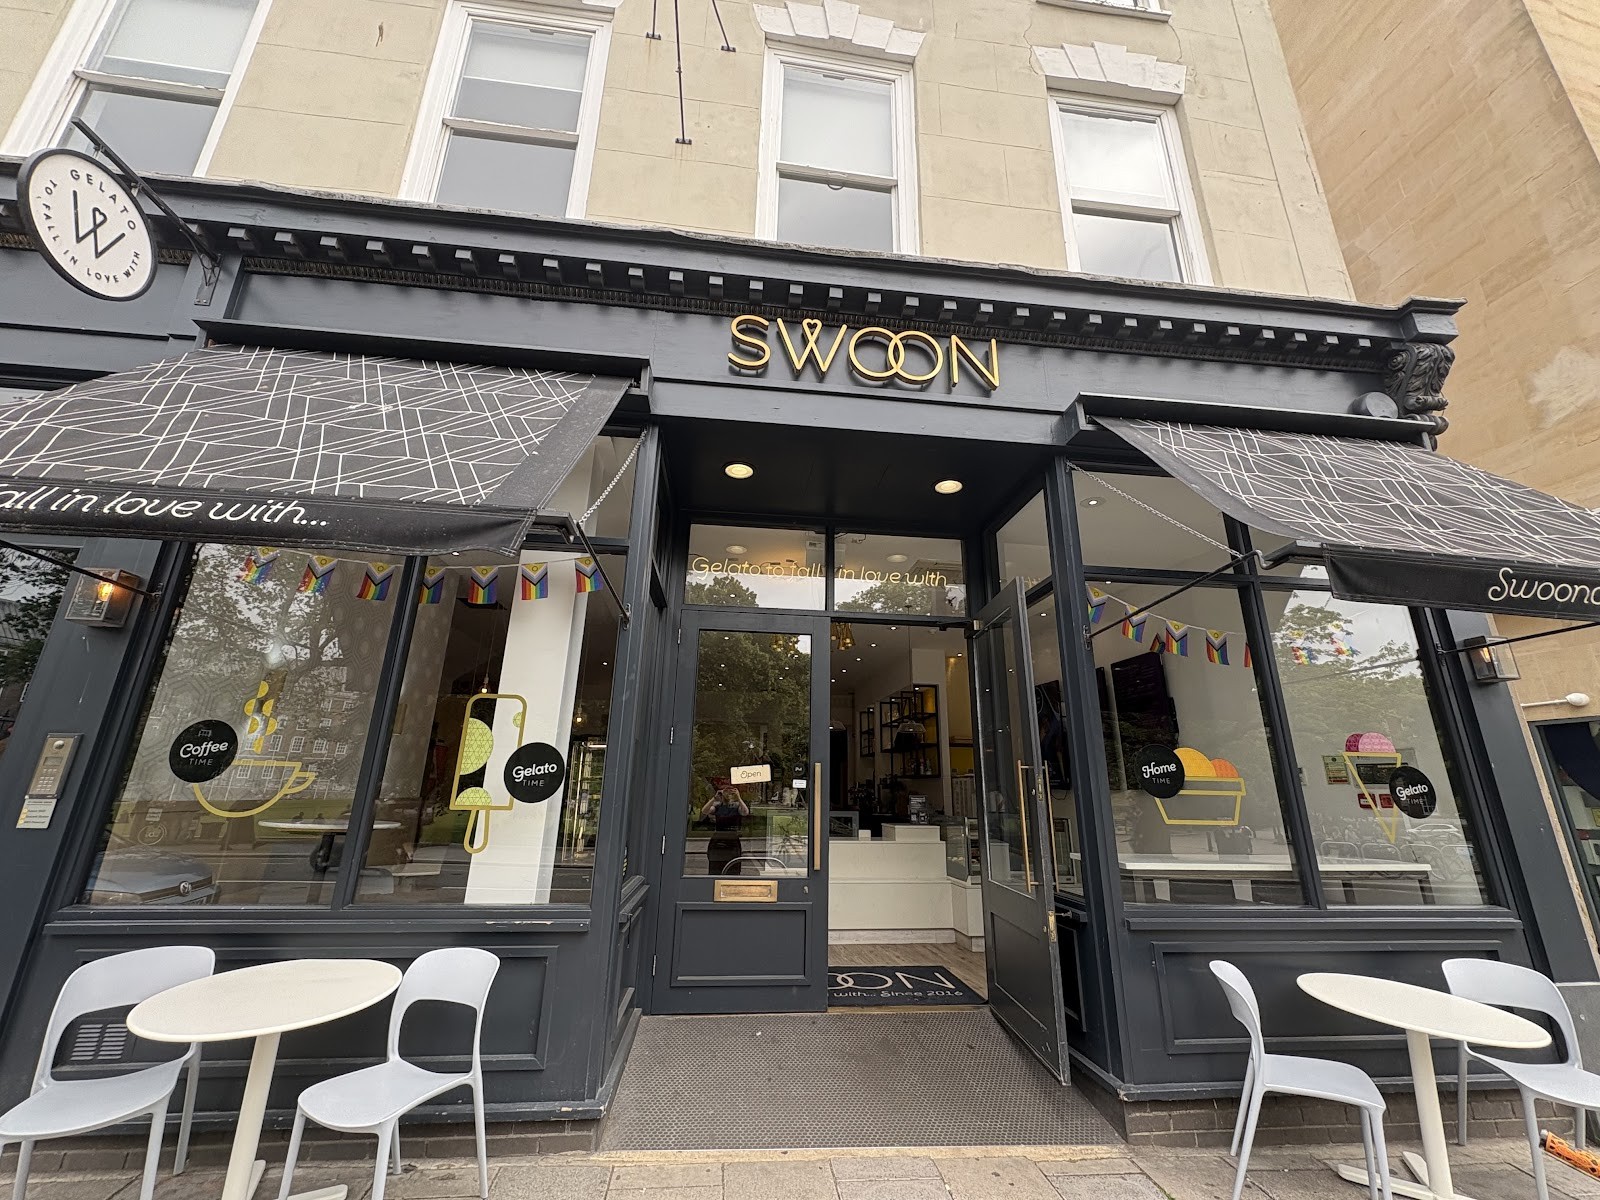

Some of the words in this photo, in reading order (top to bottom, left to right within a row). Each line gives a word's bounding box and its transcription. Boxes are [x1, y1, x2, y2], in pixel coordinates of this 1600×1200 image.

[44, 179, 58, 195] TO
[70, 169, 136, 230] GELATO
[42, 202, 60, 242] FALL
[63, 249, 79, 265] IN
[123, 251, 140, 278] WITH
[86, 268, 119, 283] LOVE
[727, 314, 1000, 391] SWOON
[0, 484, 60, 509] all
[50, 488, 99, 512] in
[102, 490, 203, 518] love
[208, 499, 328, 526] with...
[692, 556, 761, 581] Gelato
[766, 562, 784, 578] to
[790, 560, 822, 582] fall
[838, 564, 855, 581] in
[860, 565, 902, 584] love
[180, 741, 228, 758] Coffee
[189, 758, 214, 766] TIME
[1142, 762, 1177, 778] Home
[512, 763, 557, 782] Gelato
[740, 770, 762, 779] Open
[523, 779, 545, 787] TIME
[1396, 783, 1428, 800] Gelato
[880, 990, 923, 998] Since
